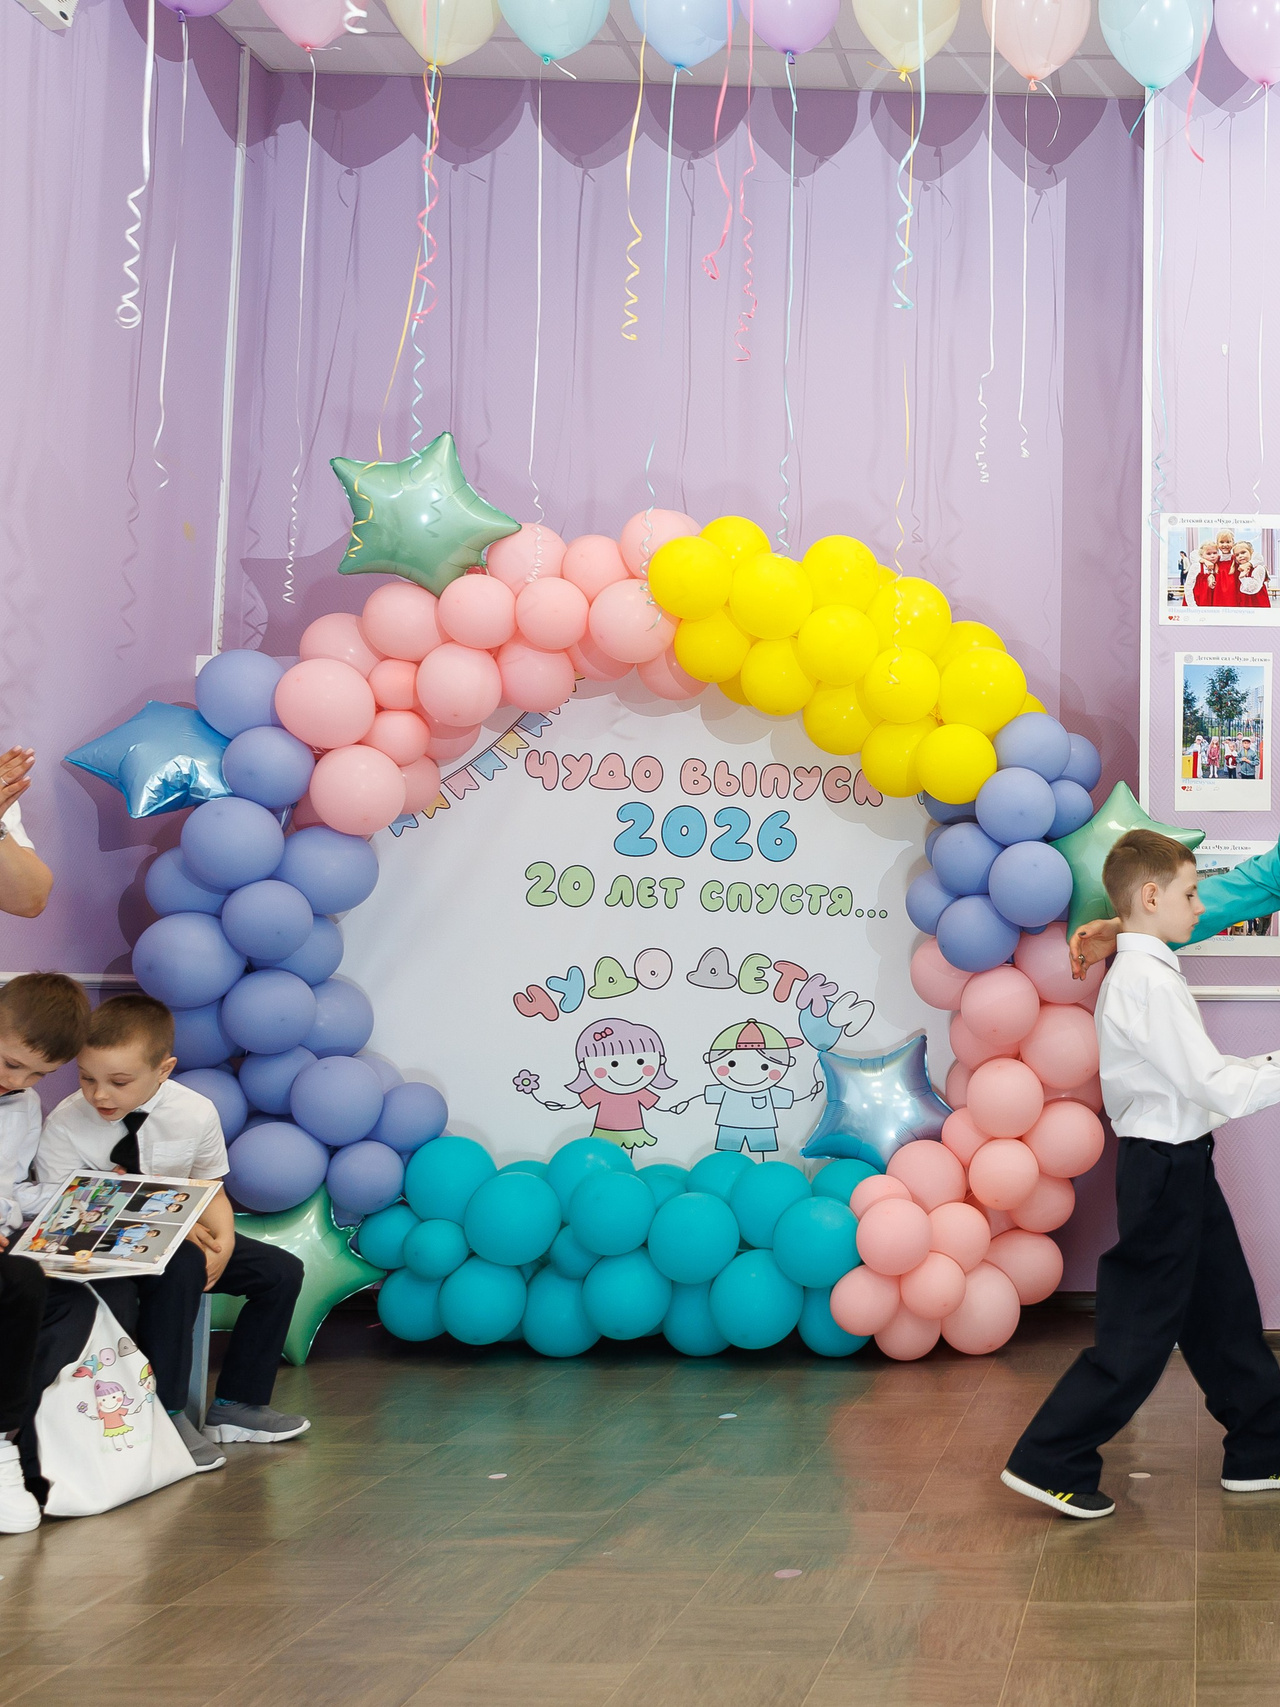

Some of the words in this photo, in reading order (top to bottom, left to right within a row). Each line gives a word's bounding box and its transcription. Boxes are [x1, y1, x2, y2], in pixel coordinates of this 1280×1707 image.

[525, 750, 664, 792] ЧУДО
[614, 801, 797, 862] 2026
[525, 861, 595, 908] 20
[605, 875, 685, 909] ЛЕТ
[700, 879, 888, 919] СПУСТЯ...
[513, 948, 673, 1022] ЧУДО
[686, 947, 875, 1037] ДЕТКИ
